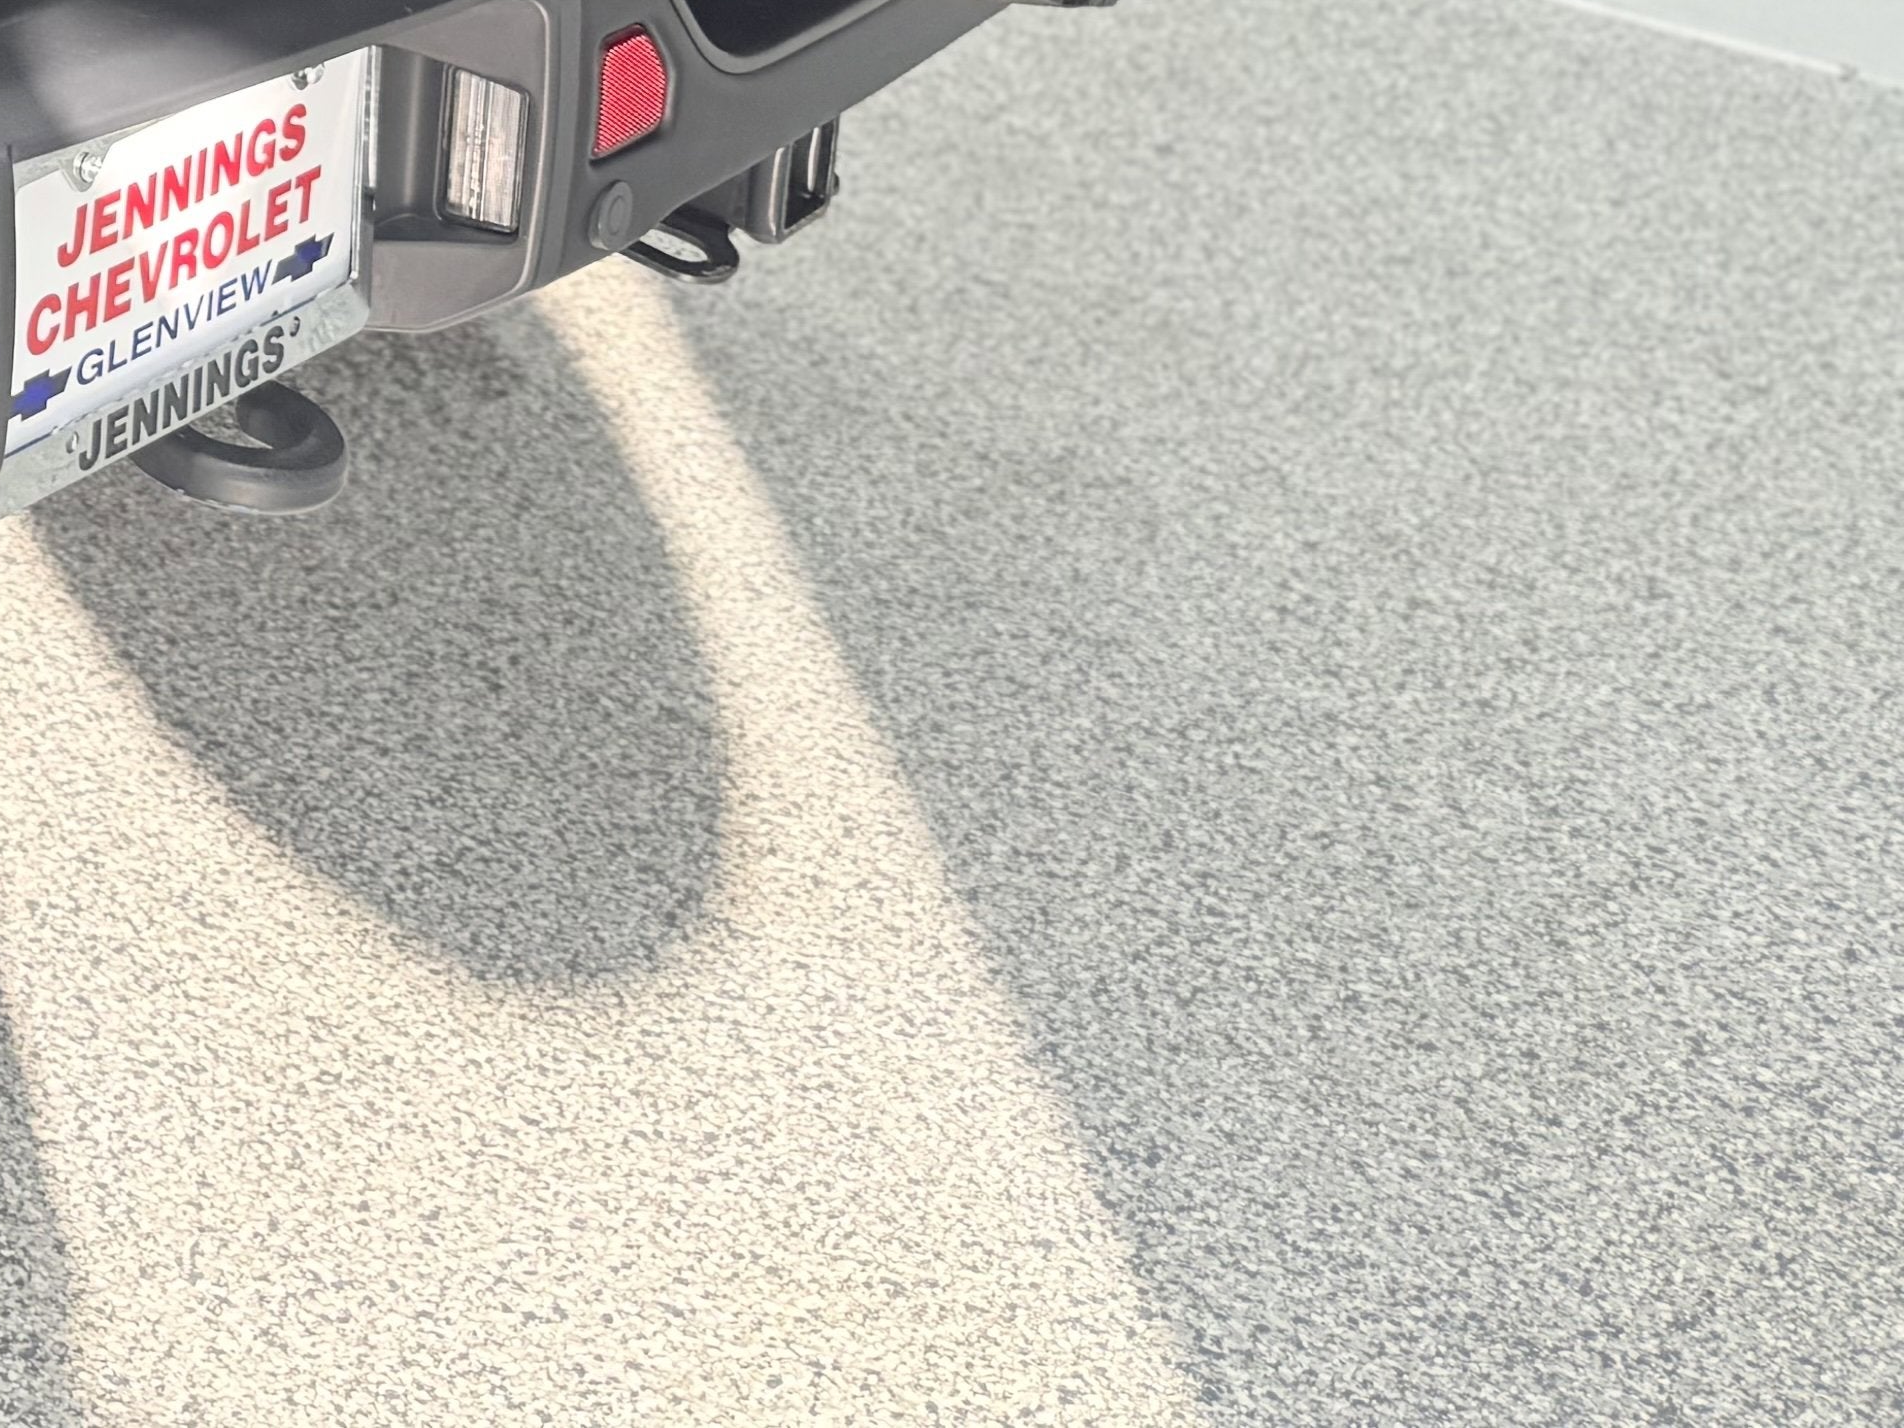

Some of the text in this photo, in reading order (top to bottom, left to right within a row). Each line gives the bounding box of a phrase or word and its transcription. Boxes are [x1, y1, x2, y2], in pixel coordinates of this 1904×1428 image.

[27, 167, 321, 354] CHEVROLET
[59, 104, 307, 267] JENNINGS
[75, 260, 273, 387] GLENVIEW
[79, 326, 284, 471] JENNINGS
